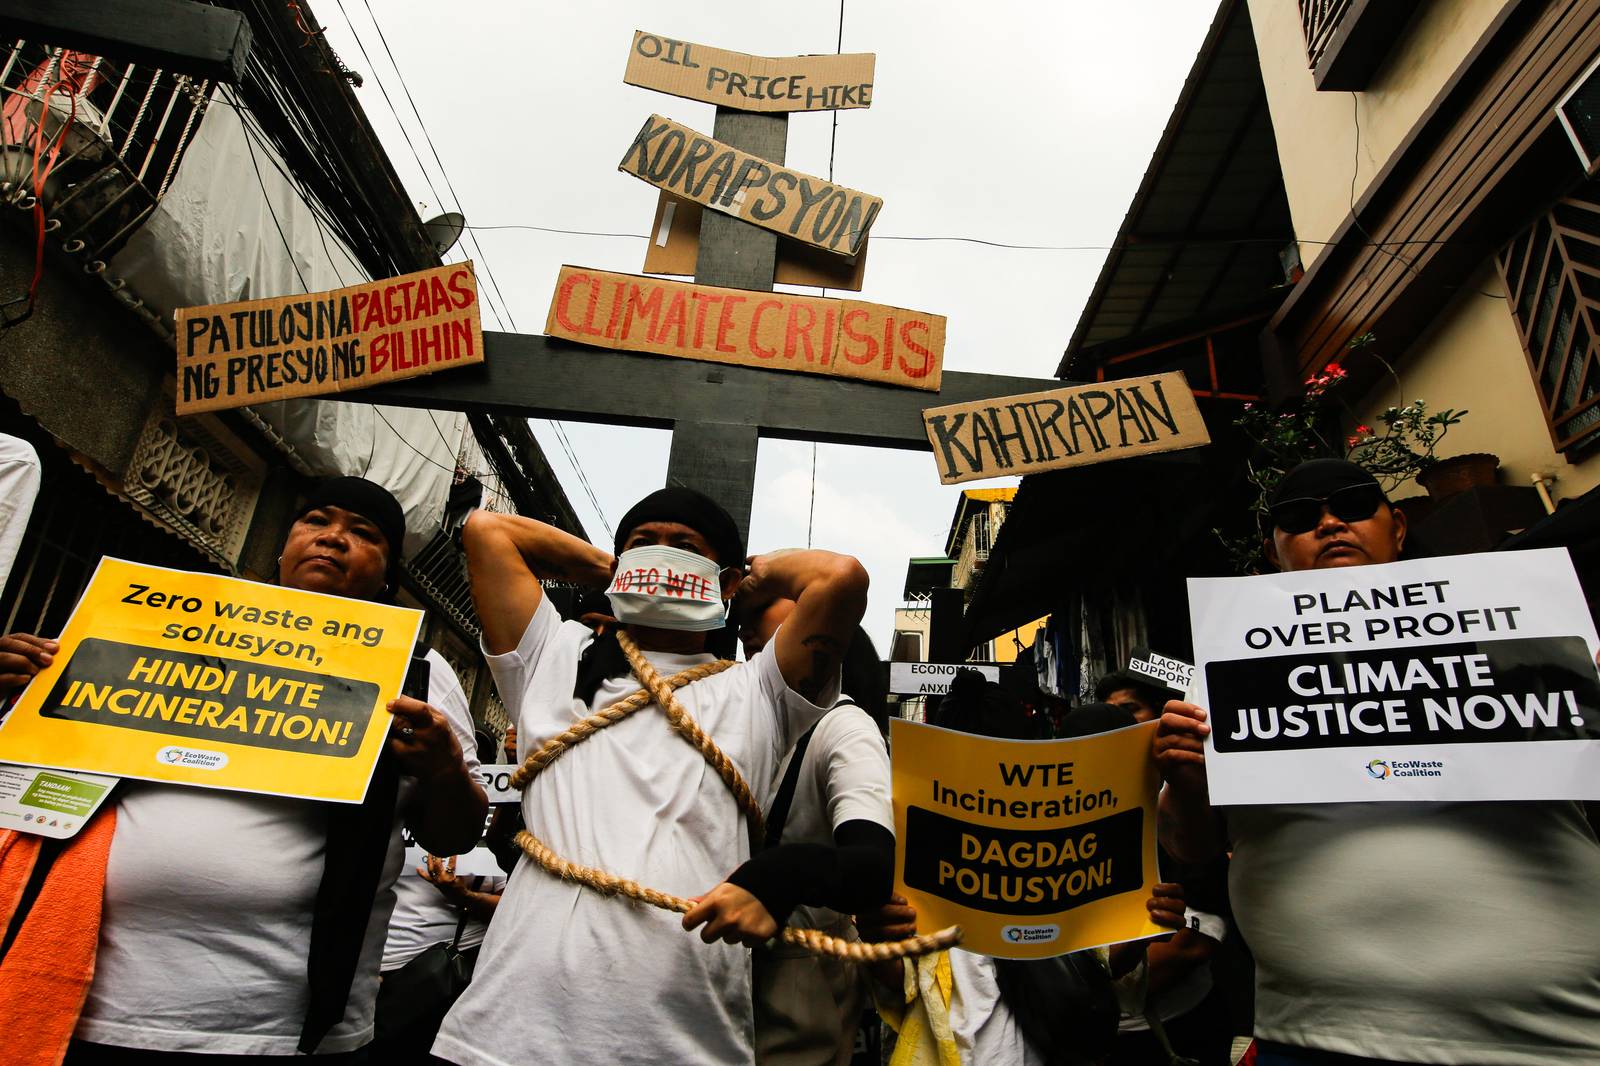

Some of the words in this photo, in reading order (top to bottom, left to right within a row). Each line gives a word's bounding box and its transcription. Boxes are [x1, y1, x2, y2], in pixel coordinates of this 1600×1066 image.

[636, 35, 700, 68] OIL
[705, 67, 806, 100] PRICE
[806, 83, 873, 109] HIKE
[621, 116, 879, 252] KORAPSYON
[187, 302, 312, 356] PATULOY
[317, 296, 352, 340] NA
[352, 270, 476, 333] PAGTAAS
[556, 273, 746, 353] CLIMATE
[748, 300, 936, 379] CRISIS
[183, 362, 219, 402] NG
[227, 345, 328, 395] PRESYO
[333, 339, 366, 381] NG
[370, 318, 474, 374] BILIHIN
[928, 380, 1180, 479] KAHIRAPAN
[611, 570, 633, 593] NO
[635, 568, 660, 595] TO
[666, 569, 713, 601] WTE
[1293, 580, 1450, 616] PLANET
[121, 584, 202, 613] Zero
[214, 601, 313, 632] waste
[326, 619, 385, 647] ang
[1244, 621, 1353, 650] OVER
[1365, 606, 1521, 642] PROFIT
[162, 622, 324, 666] solusyon,
[1150, 655, 1184, 673] LACK
[128, 656, 238, 695] HINDI
[246, 673, 324, 710] WTE
[911, 664, 978, 675] ECONO
[1131, 660, 1191, 686] SUPPORT
[1287, 653, 1494, 697] CLIMATE
[60, 681, 354, 746] INCINERATION!
[1230, 699, 1412, 741] JUSTICE
[1422, 690, 1585, 732] NOW!
[182, 758, 216, 767] Coalition
[184, 751, 221, 761] EcoWaste
[999, 762, 1073, 787] WTE
[1391, 760, 1443, 768] EcoWaste
[1393, 769, 1442, 777] Coalition
[933, 779, 1118, 819] Incineration,
[961, 832, 1097, 869] DAGDAG
[939, 858, 1112, 904] POLUSYON!
